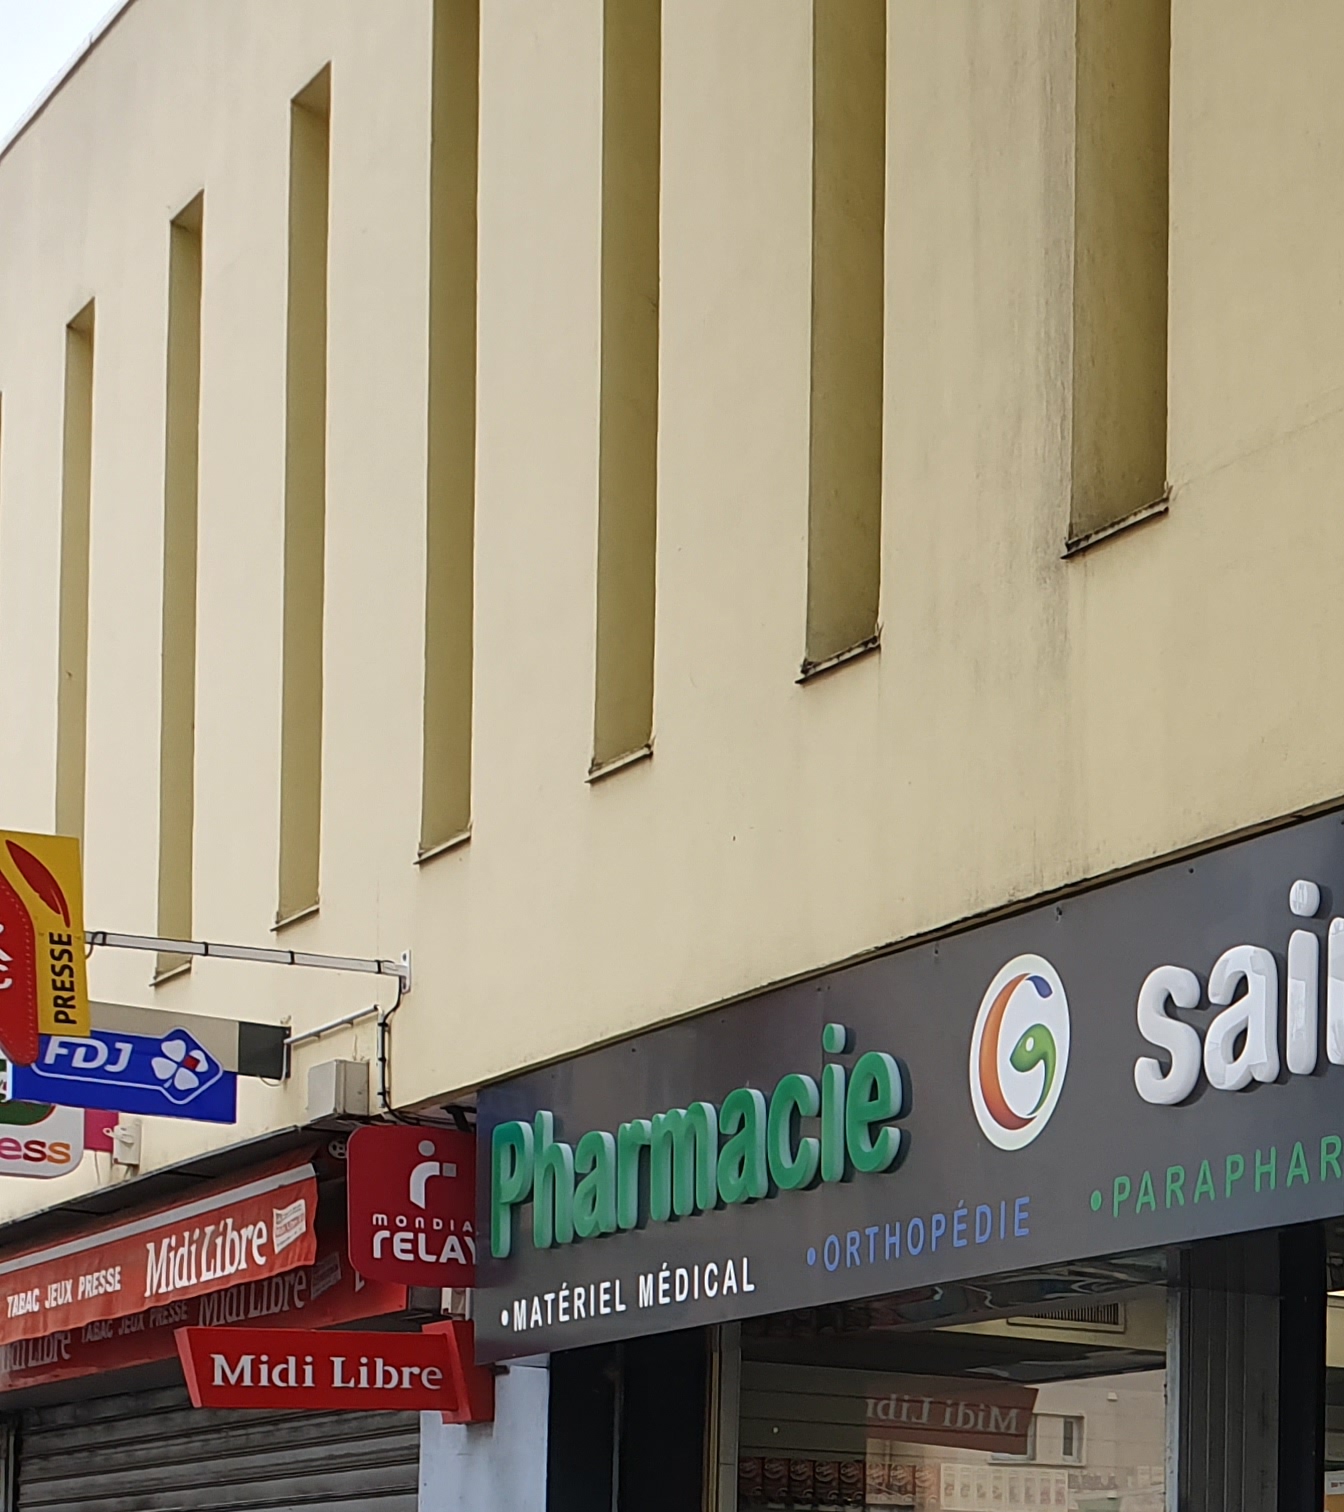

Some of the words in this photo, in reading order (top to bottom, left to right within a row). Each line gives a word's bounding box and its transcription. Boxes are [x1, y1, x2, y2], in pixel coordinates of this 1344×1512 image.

[49, 931, 77, 1025] PRESSE
[44, 1035, 133, 1073] FDJ
[491, 1023, 901, 1259] Pharmacie
[823, 1196, 1031, 1272] ORTHOPÉDIE
[6, 1288, 40, 1318] TABAC
[44, 1278, 73, 1309] JEUX
[78, 1266, 121, 1301] PRESSE
[513, 1273, 626, 1332] MATÉRIEL
[638, 1256, 756, 1311] MÉDICAL
[210, 1353, 315, 1389] Midi
[331, 1356, 443, 1390] Libre
